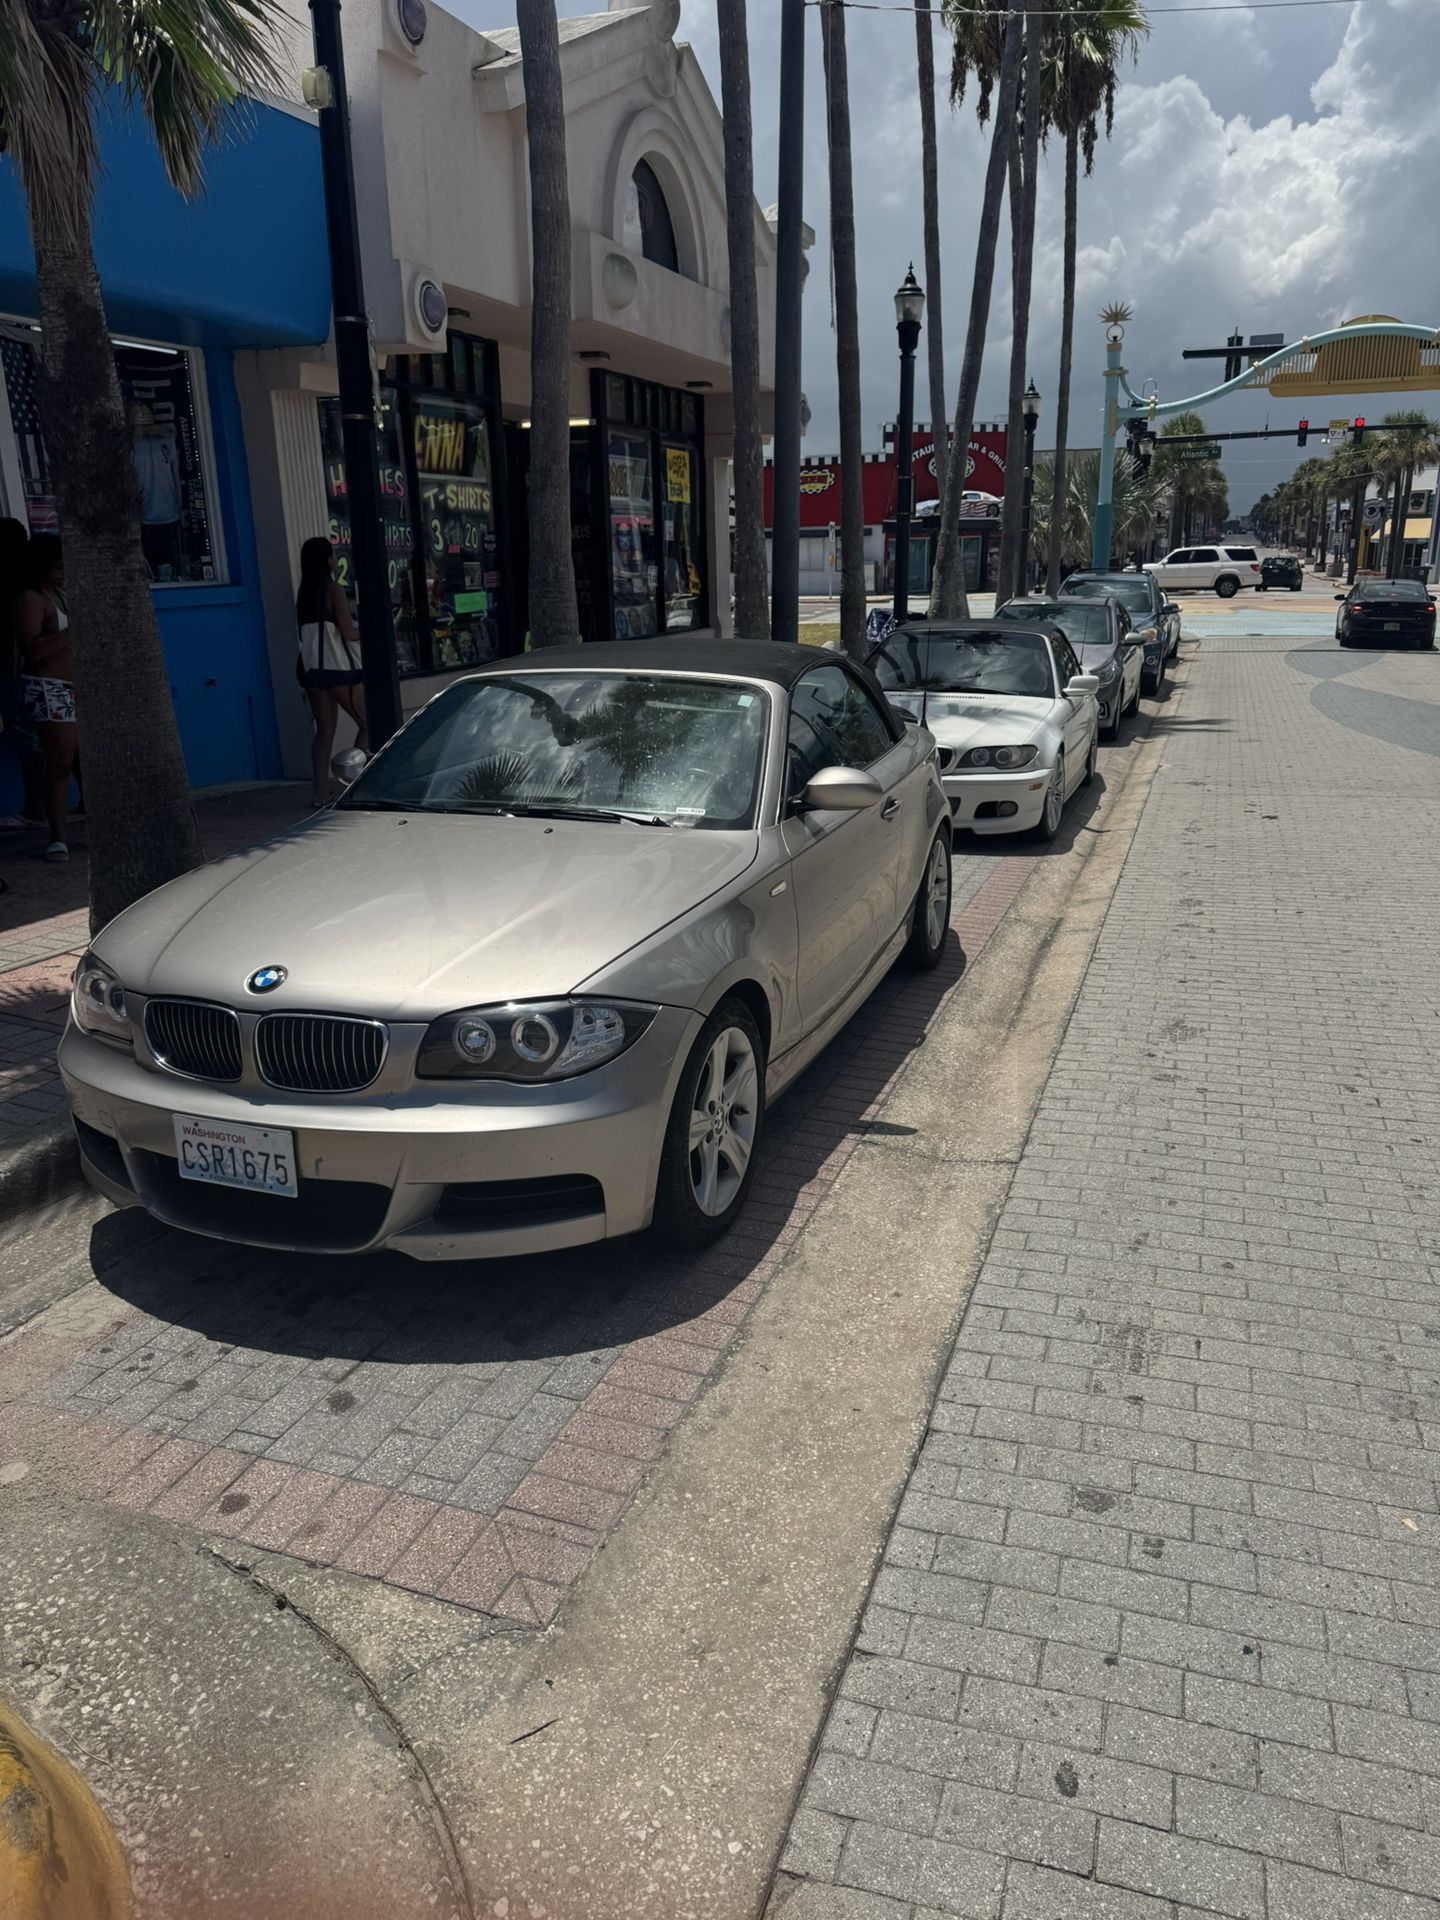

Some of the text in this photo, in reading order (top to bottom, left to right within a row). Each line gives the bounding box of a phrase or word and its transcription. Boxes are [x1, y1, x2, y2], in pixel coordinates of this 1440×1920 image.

[414, 414, 465, 470] ENNA
[967, 442, 980, 451] AR
[981, 446, 986, 454] &
[1180, 449, 1209, 459] Atlantic
[424, 483, 491, 513] T-SHIRTS
[431, 518, 444, 551] 3
[336, 556, 348, 587] 2
[182, 1125, 246, 1145] WASHINGTON
[182, 1140, 289, 1186] CSR1675
